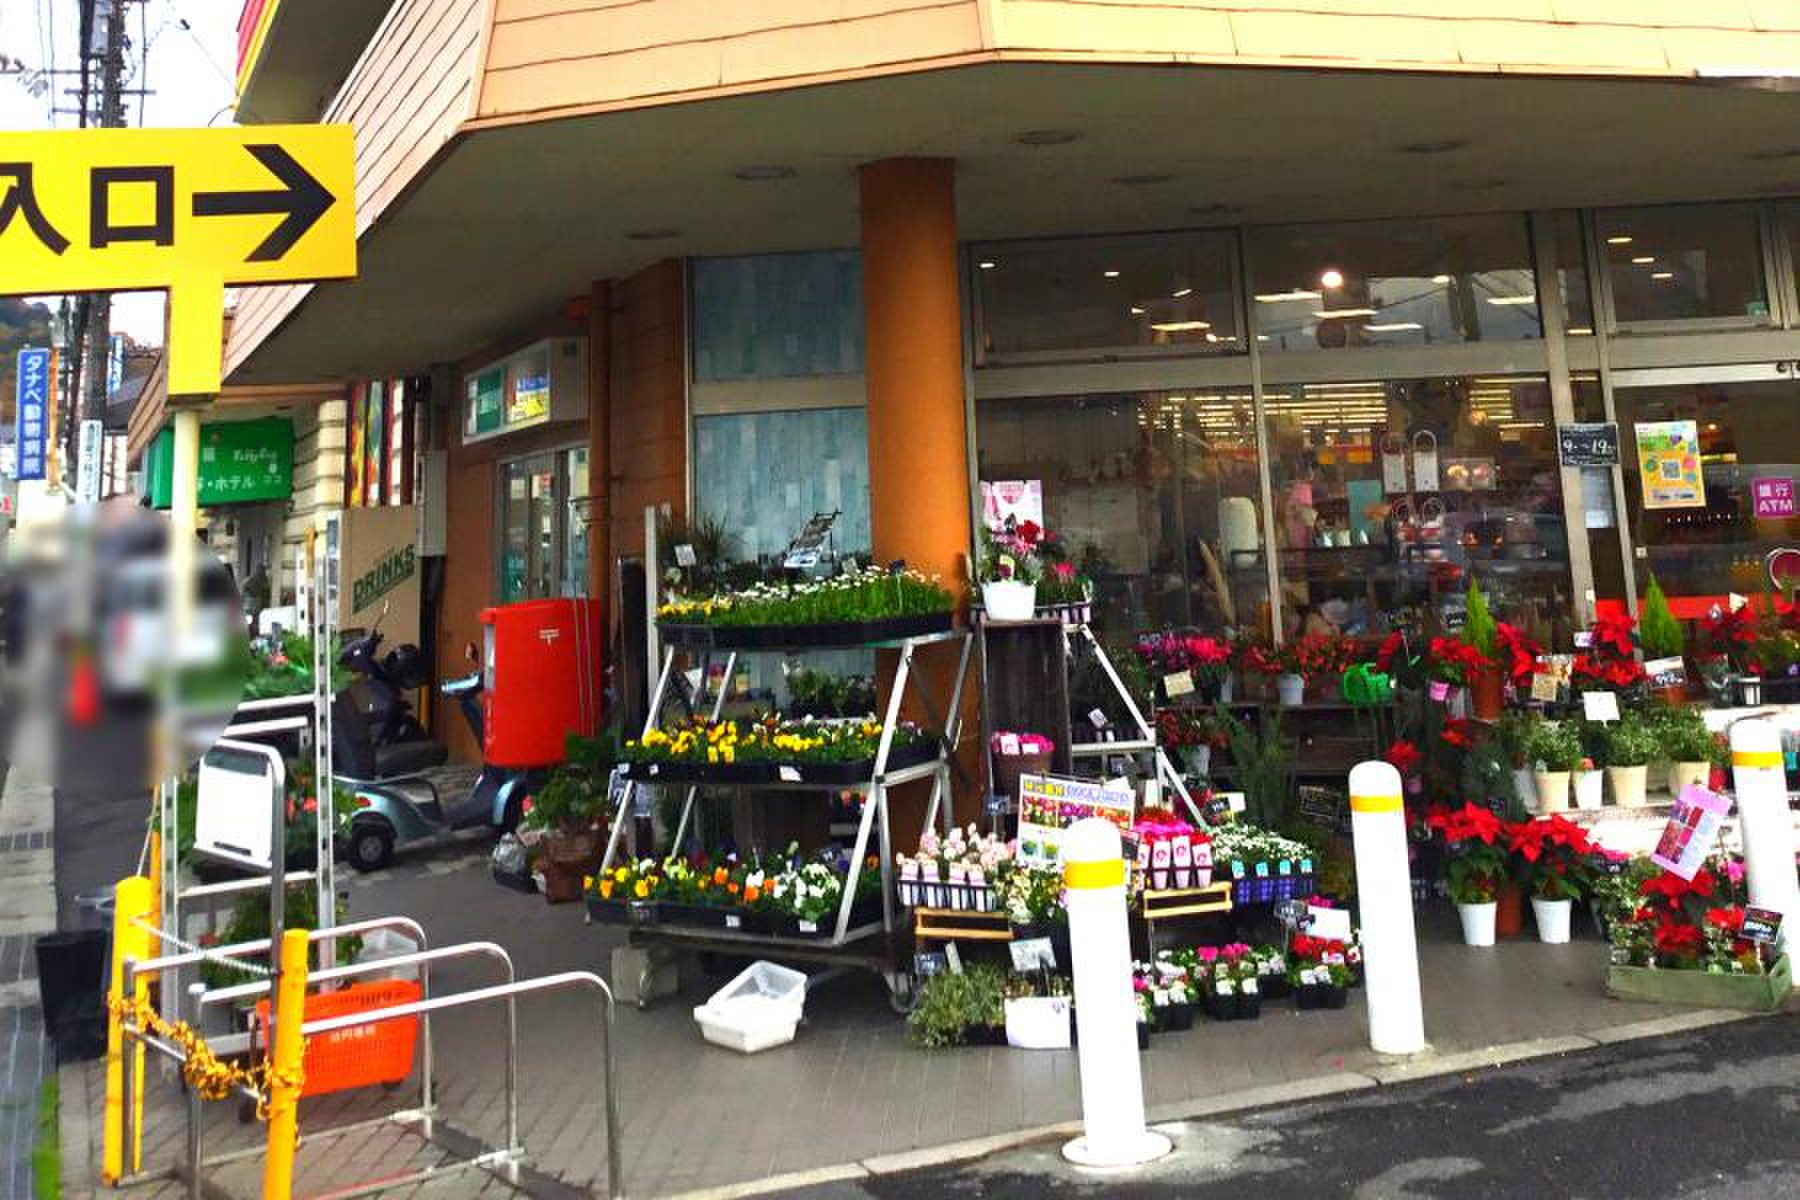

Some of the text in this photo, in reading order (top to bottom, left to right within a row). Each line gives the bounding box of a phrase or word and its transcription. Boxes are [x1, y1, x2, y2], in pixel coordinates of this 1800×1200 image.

[0, 161, 175, 256] 入口
[1759, 498, 1793, 513] ATM
[352, 544, 415, 606] DRINKS
